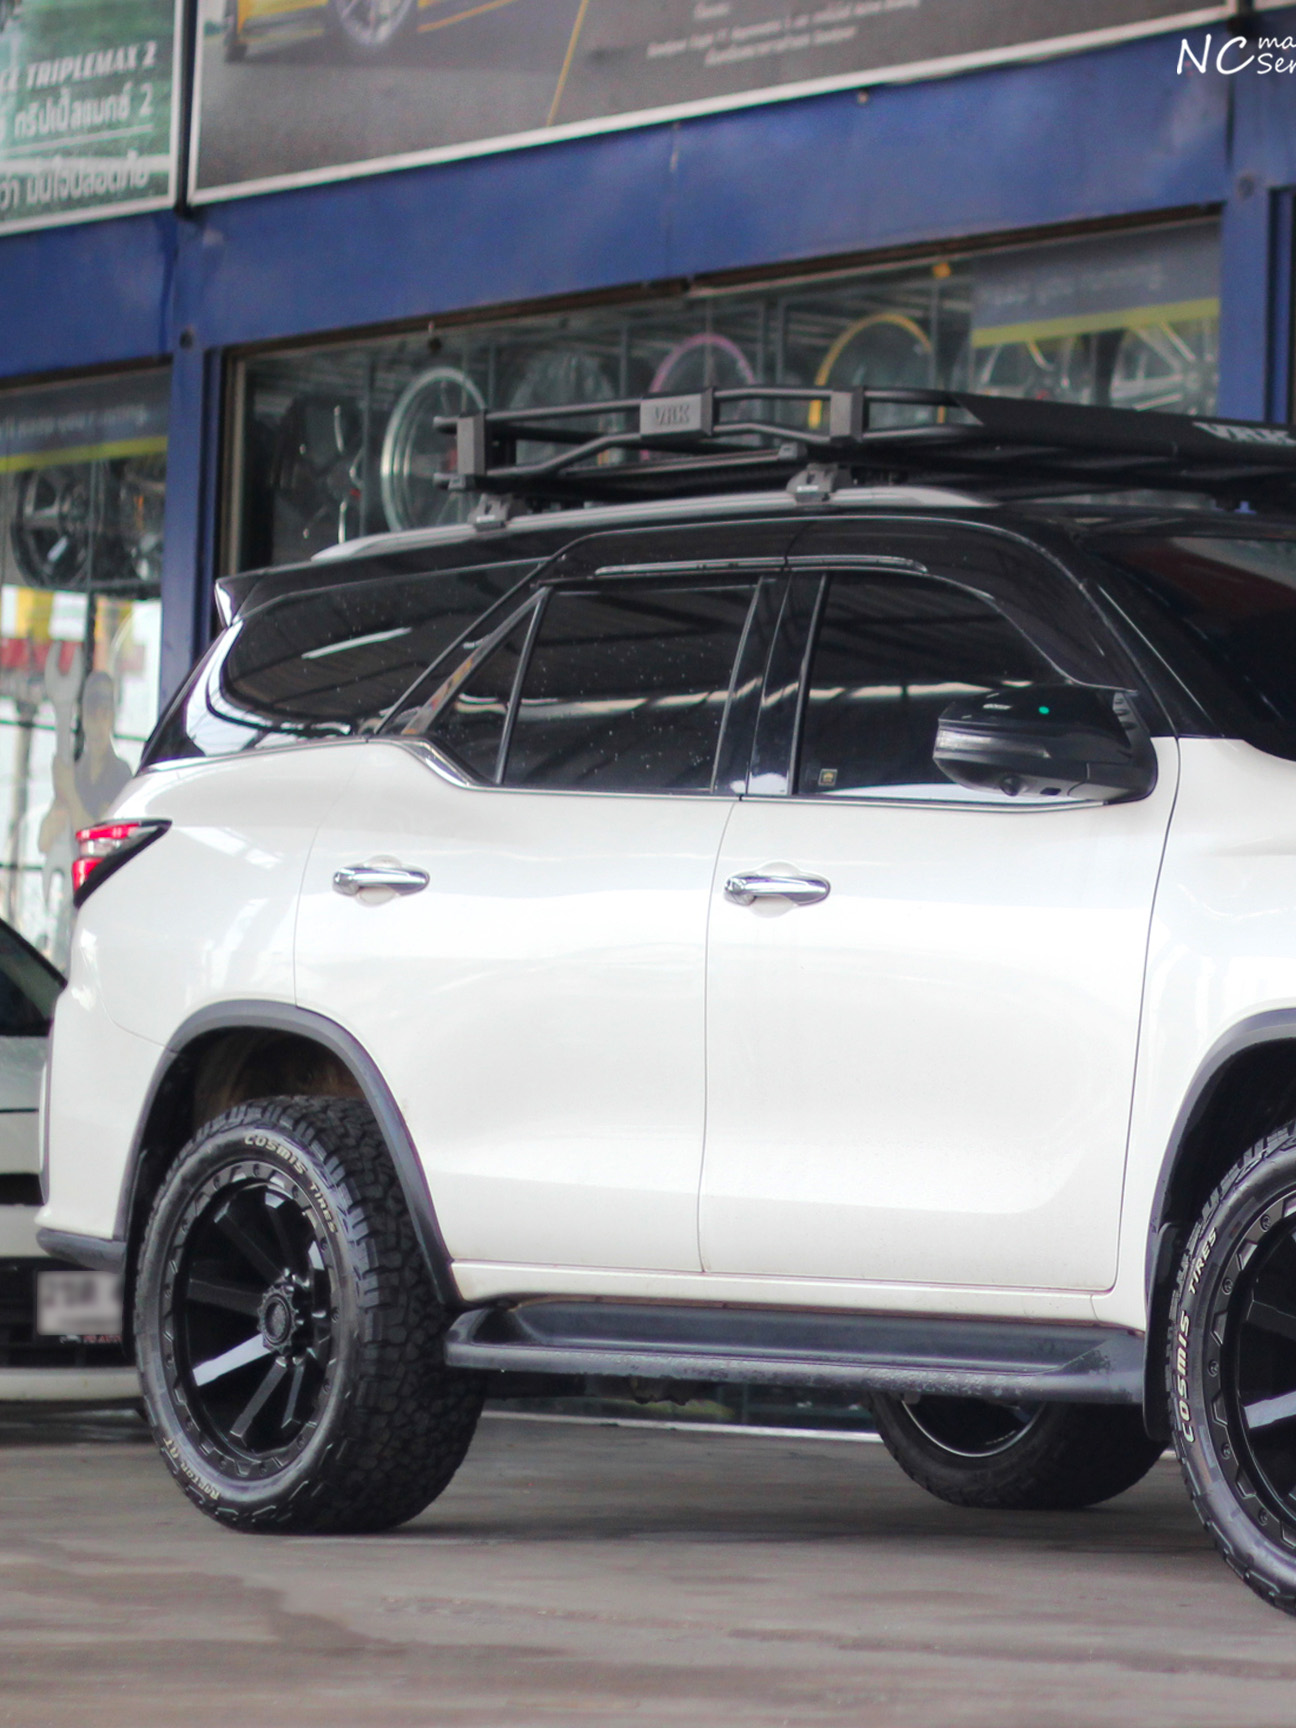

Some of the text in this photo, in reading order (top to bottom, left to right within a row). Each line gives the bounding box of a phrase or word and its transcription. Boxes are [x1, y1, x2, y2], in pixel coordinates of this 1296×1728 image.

[141, 40, 157, 68] 2
[140, 82, 153, 117] 2
[244, 1134, 307, 1175] COSMIS
[1176, 1226, 1218, 1443] COSMIS TIRES
